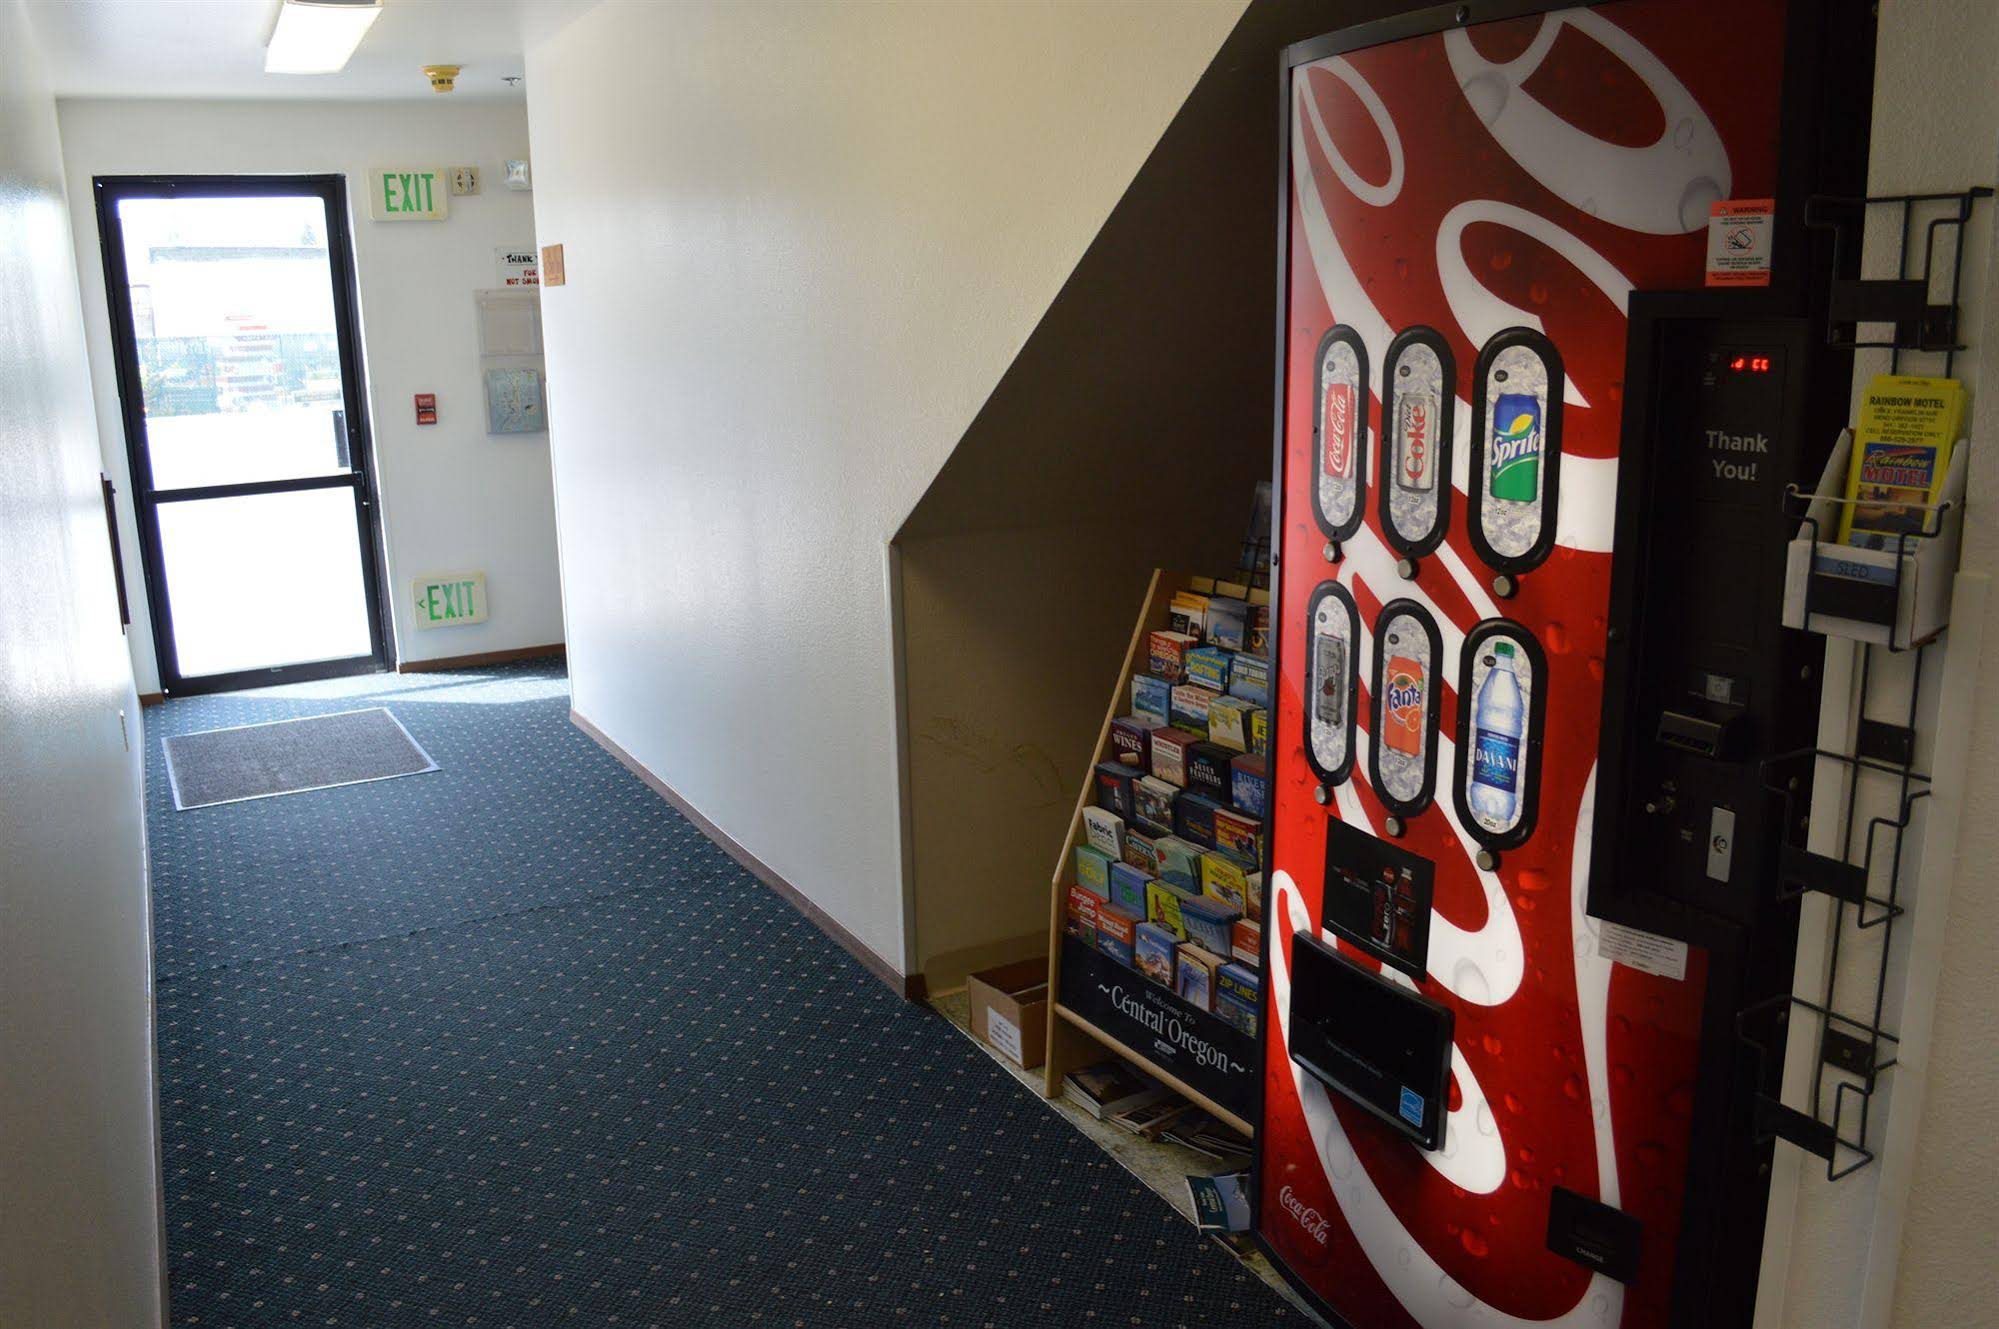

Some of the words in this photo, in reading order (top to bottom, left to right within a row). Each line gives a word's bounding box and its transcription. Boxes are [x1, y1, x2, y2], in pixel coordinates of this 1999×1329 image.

[383, 173, 434, 212] EXIT
[1733, 205, 1768, 214] WARNING
[506, 254, 533, 264] THANK
[1869, 396, 1912, 407] RAINBOW
[1914, 398, 1945, 409] MOTEL
[1405, 404, 1426, 480] Coke
[1492, 426, 1539, 468] Sprite
[1705, 430, 1768, 453] Thank
[1712, 459, 1756, 481] You!
[1864, 450, 1928, 468] Rainbow
[1862, 467, 1928, 487] MOTEL
[427, 581, 475, 621] EXIT
[1113, 733, 1143, 752] WINES
[1475, 748, 1517, 772] DASANI
[1088, 818, 1113, 838] Fabric
[1071, 887, 1095, 907] Bungee
[1219, 975, 1233, 989] ZIP
[1234, 980, 1258, 1002] LINES
[1145, 990, 1183, 1017] Welcome
[1184, 1012, 1197, 1025] To
[1111, 985, 1164, 1035] Central
[1168, 1018, 1229, 1073] Oregon
